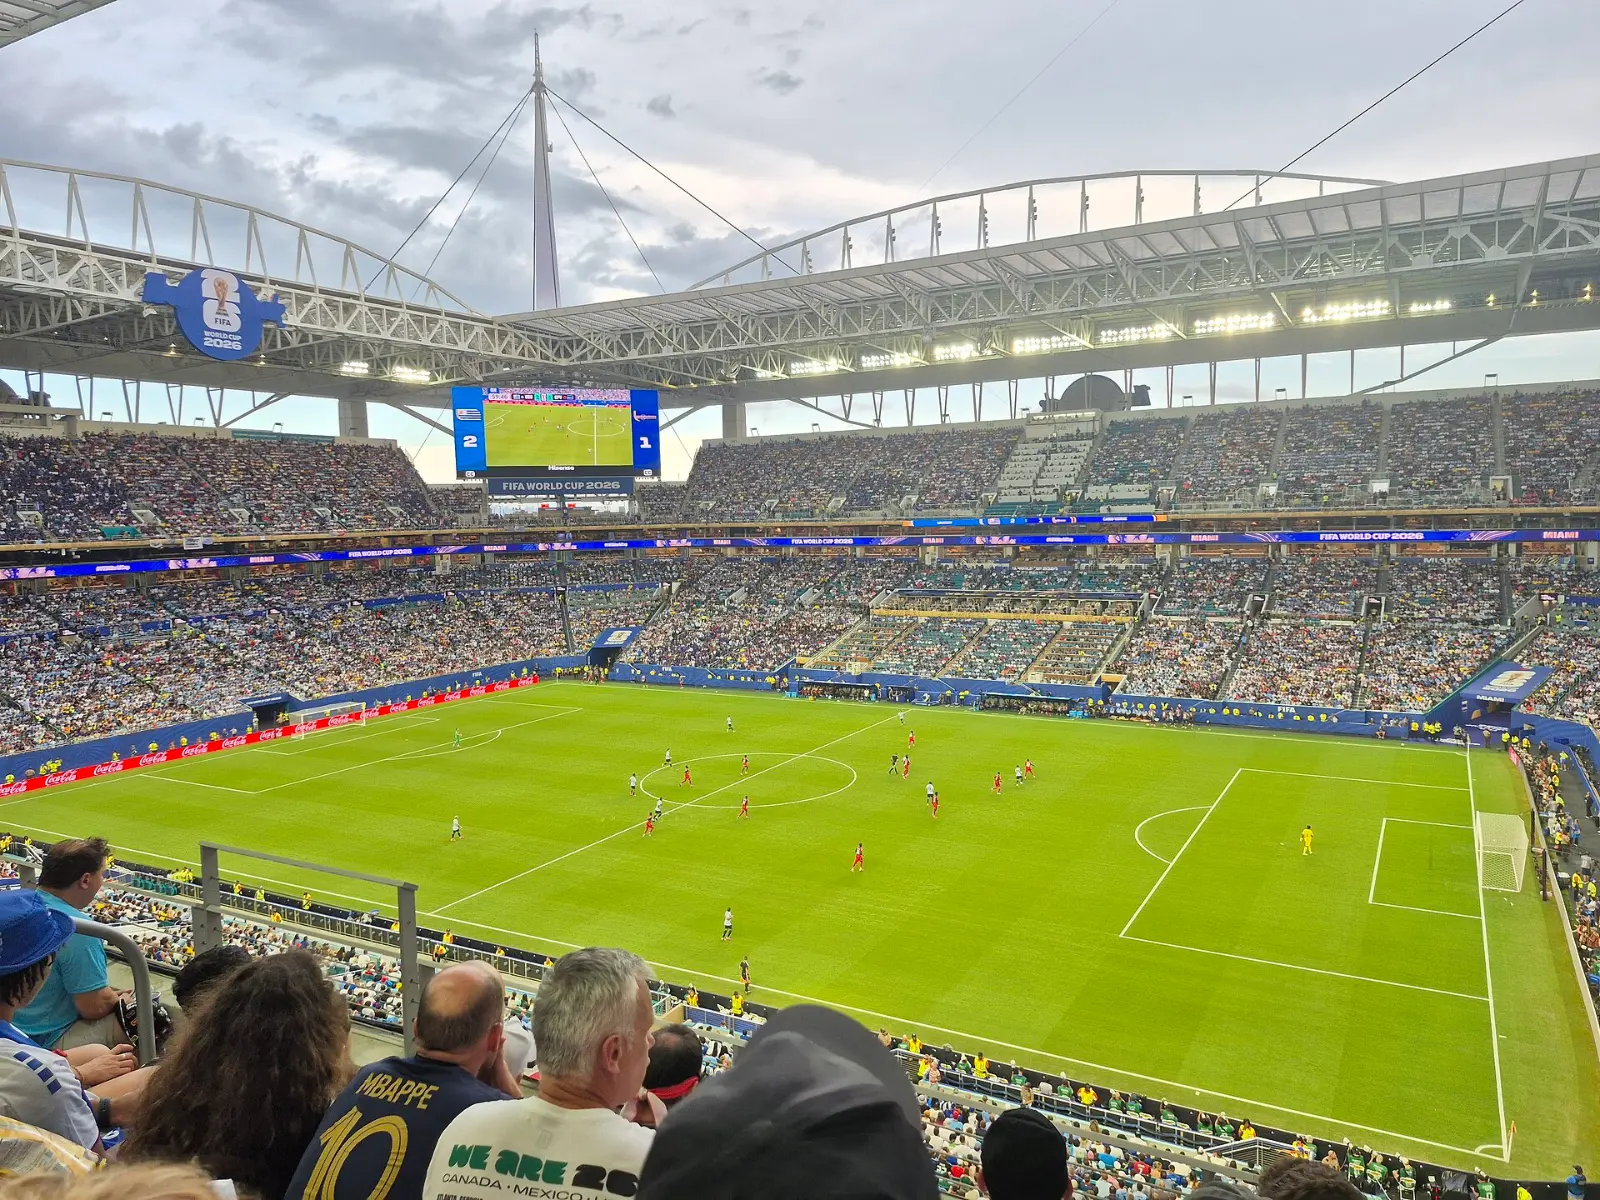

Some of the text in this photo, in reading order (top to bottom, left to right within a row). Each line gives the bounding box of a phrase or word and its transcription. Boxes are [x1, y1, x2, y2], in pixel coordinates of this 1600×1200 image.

[215, 318, 232, 326] FIFA
[204, 330, 228, 338] WORLD
[204, 337, 242, 350] 2026
[463, 436, 478, 448] 2
[640, 436, 652, 448] 1
[502, 482, 525, 490] FIFA
[526, 482, 563, 490] WORLD
[564, 482, 584, 490] CUP
[182, 742, 208, 757] Coca-Cola
[222, 735, 247, 749] Coca-Cola
[140, 750, 168, 766] Coca-Cola
[94, 760, 124, 776] Coca-Cola
[45, 769, 78, 786] Coca-Cola
[355, 1072, 440, 1110] MBAPPE
[303, 1105, 408, 1200] 10
[448, 1144, 492, 1170] WE
[494, 1149, 568, 1185] ARE
[442, 1173, 583, 1200] CANADA MEXICO
